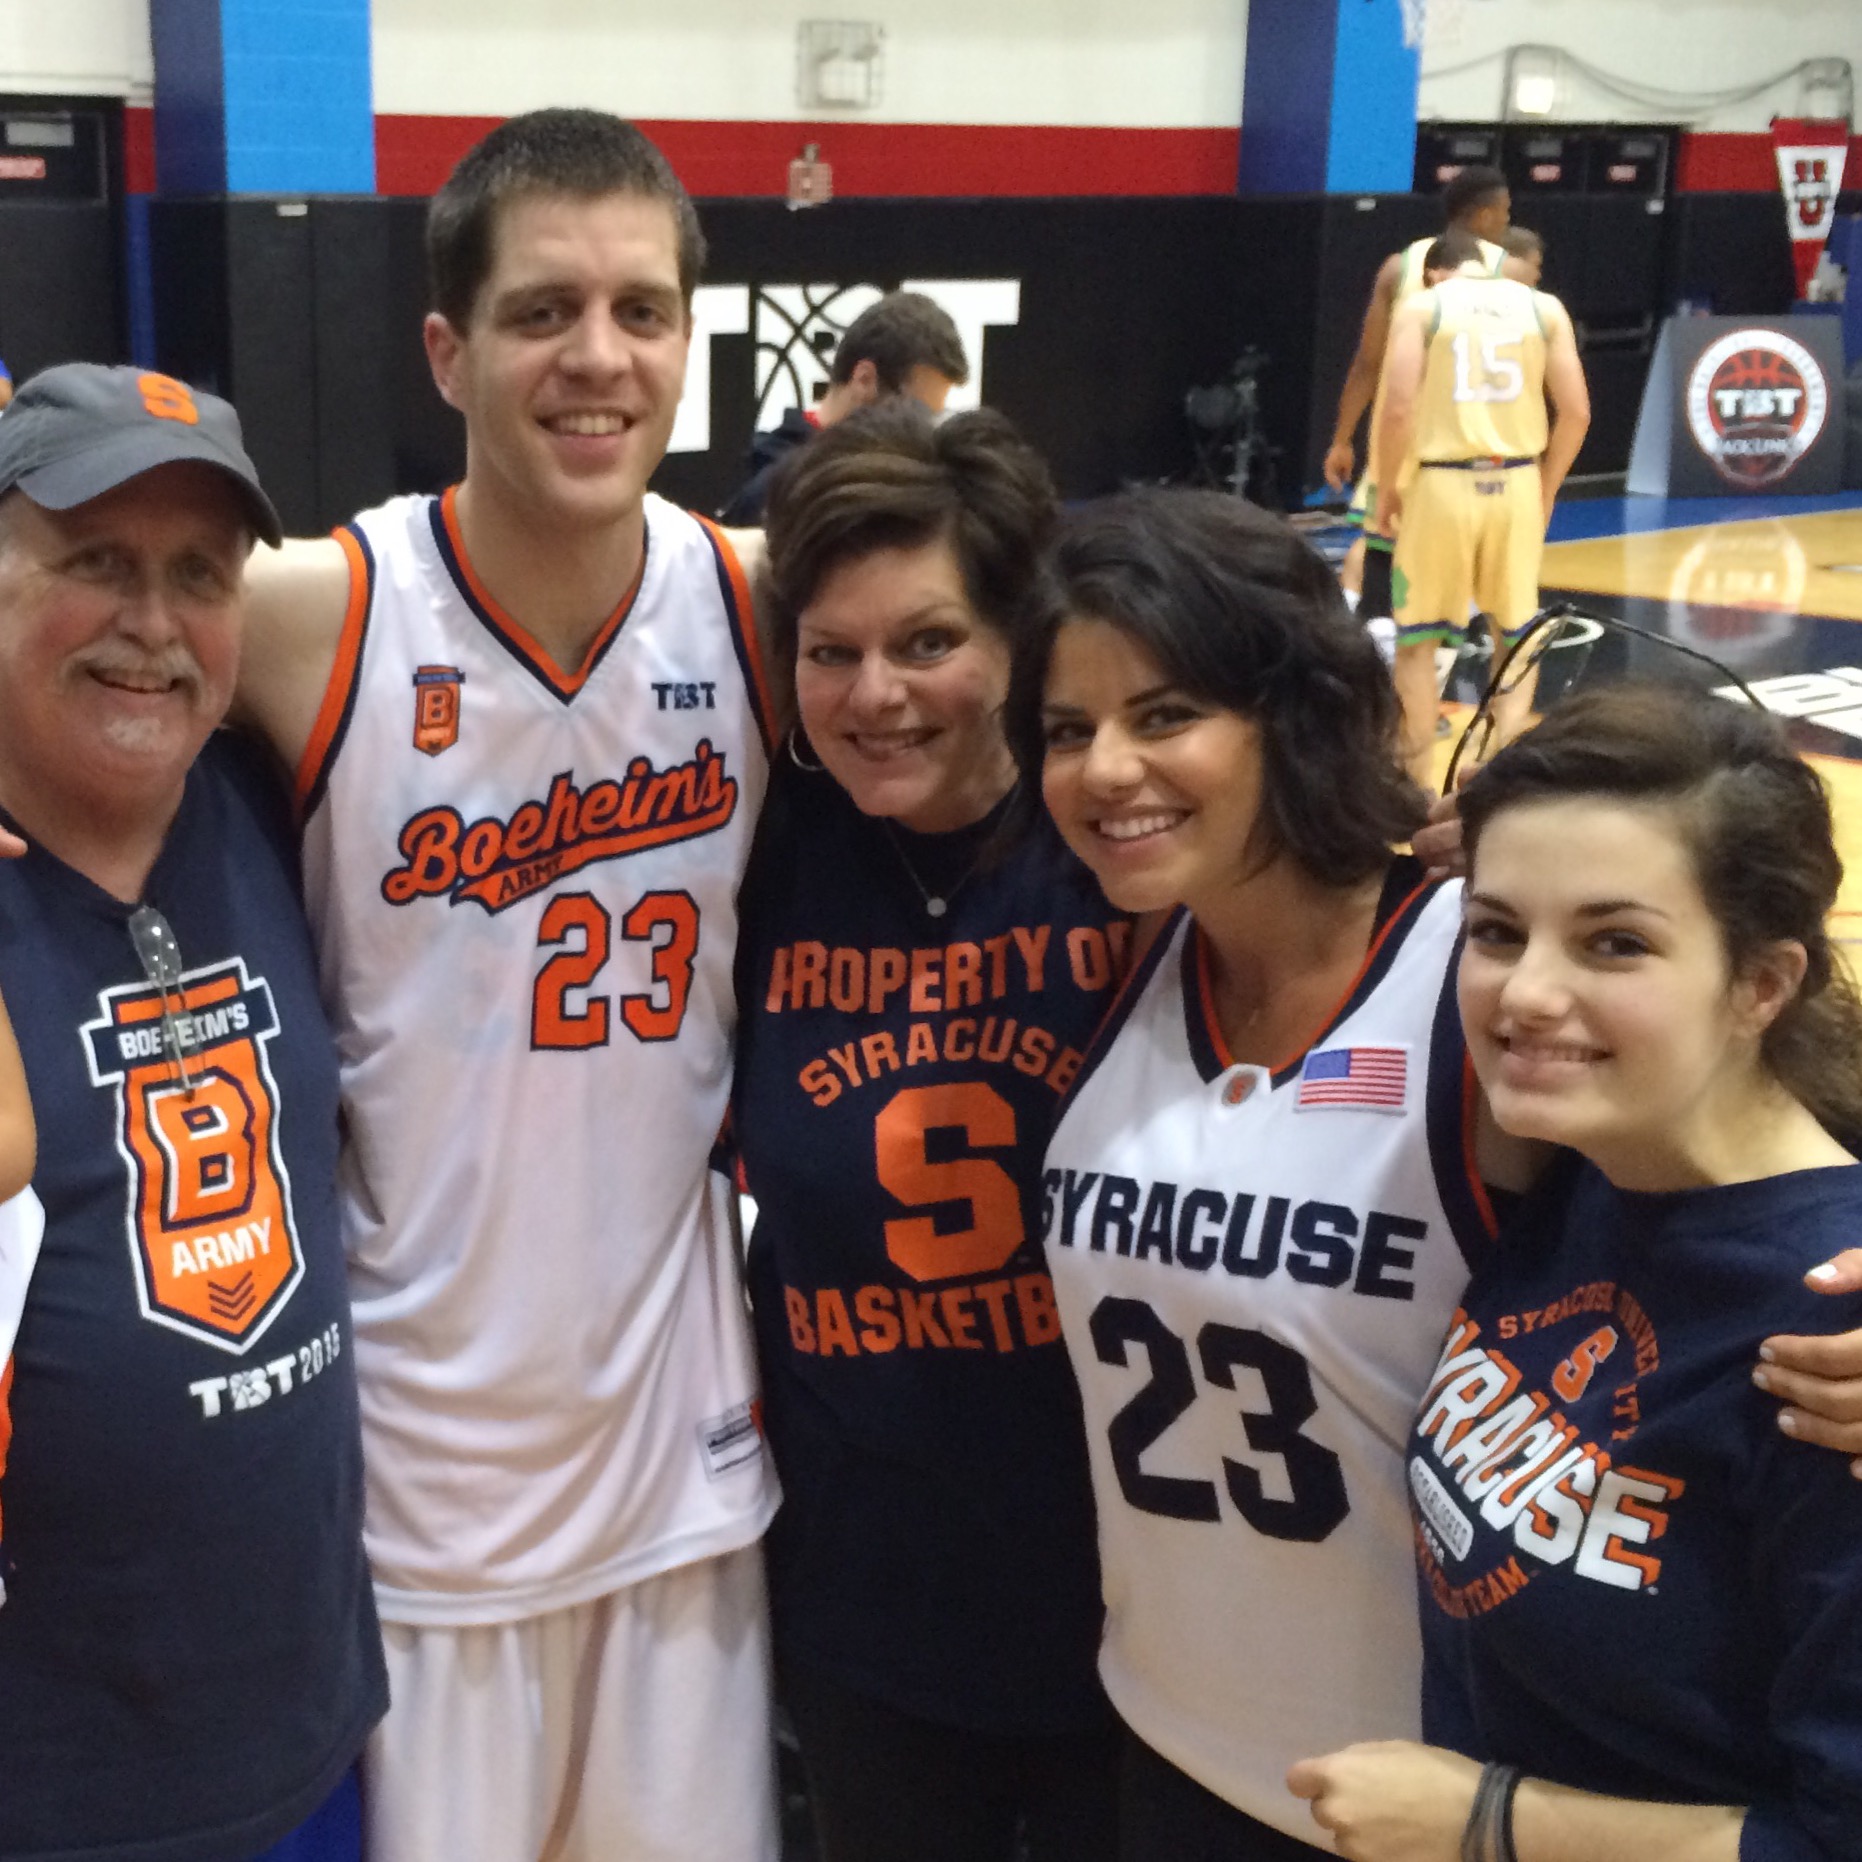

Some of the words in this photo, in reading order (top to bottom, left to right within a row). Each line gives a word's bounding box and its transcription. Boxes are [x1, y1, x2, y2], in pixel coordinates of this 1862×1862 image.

[138, 372, 198, 425] S
[1452, 331, 1524, 403] 15
[421, 687, 454, 728] B
[651, 680, 718, 711] TBT
[381, 738, 732, 907] Boeheim's
[497, 855, 564, 900] ARMY
[530, 889, 701, 1051] 23
[797, 1017, 1084, 1107] SYRACUSE
[142, 1066, 258, 1233] B
[875, 1081, 1025, 1282] S
[171, 1217, 274, 1279] ARMY
[1041, 1168, 1428, 1301] SYRACUSE
[785, 1272, 1062, 1357] BASKETB
[189, 1353, 298, 1419] TBT
[1552, 1325, 1620, 1404] S
[1089, 1295, 1351, 1544] 23
[1417, 1310, 1686, 1591] YRACUSE
